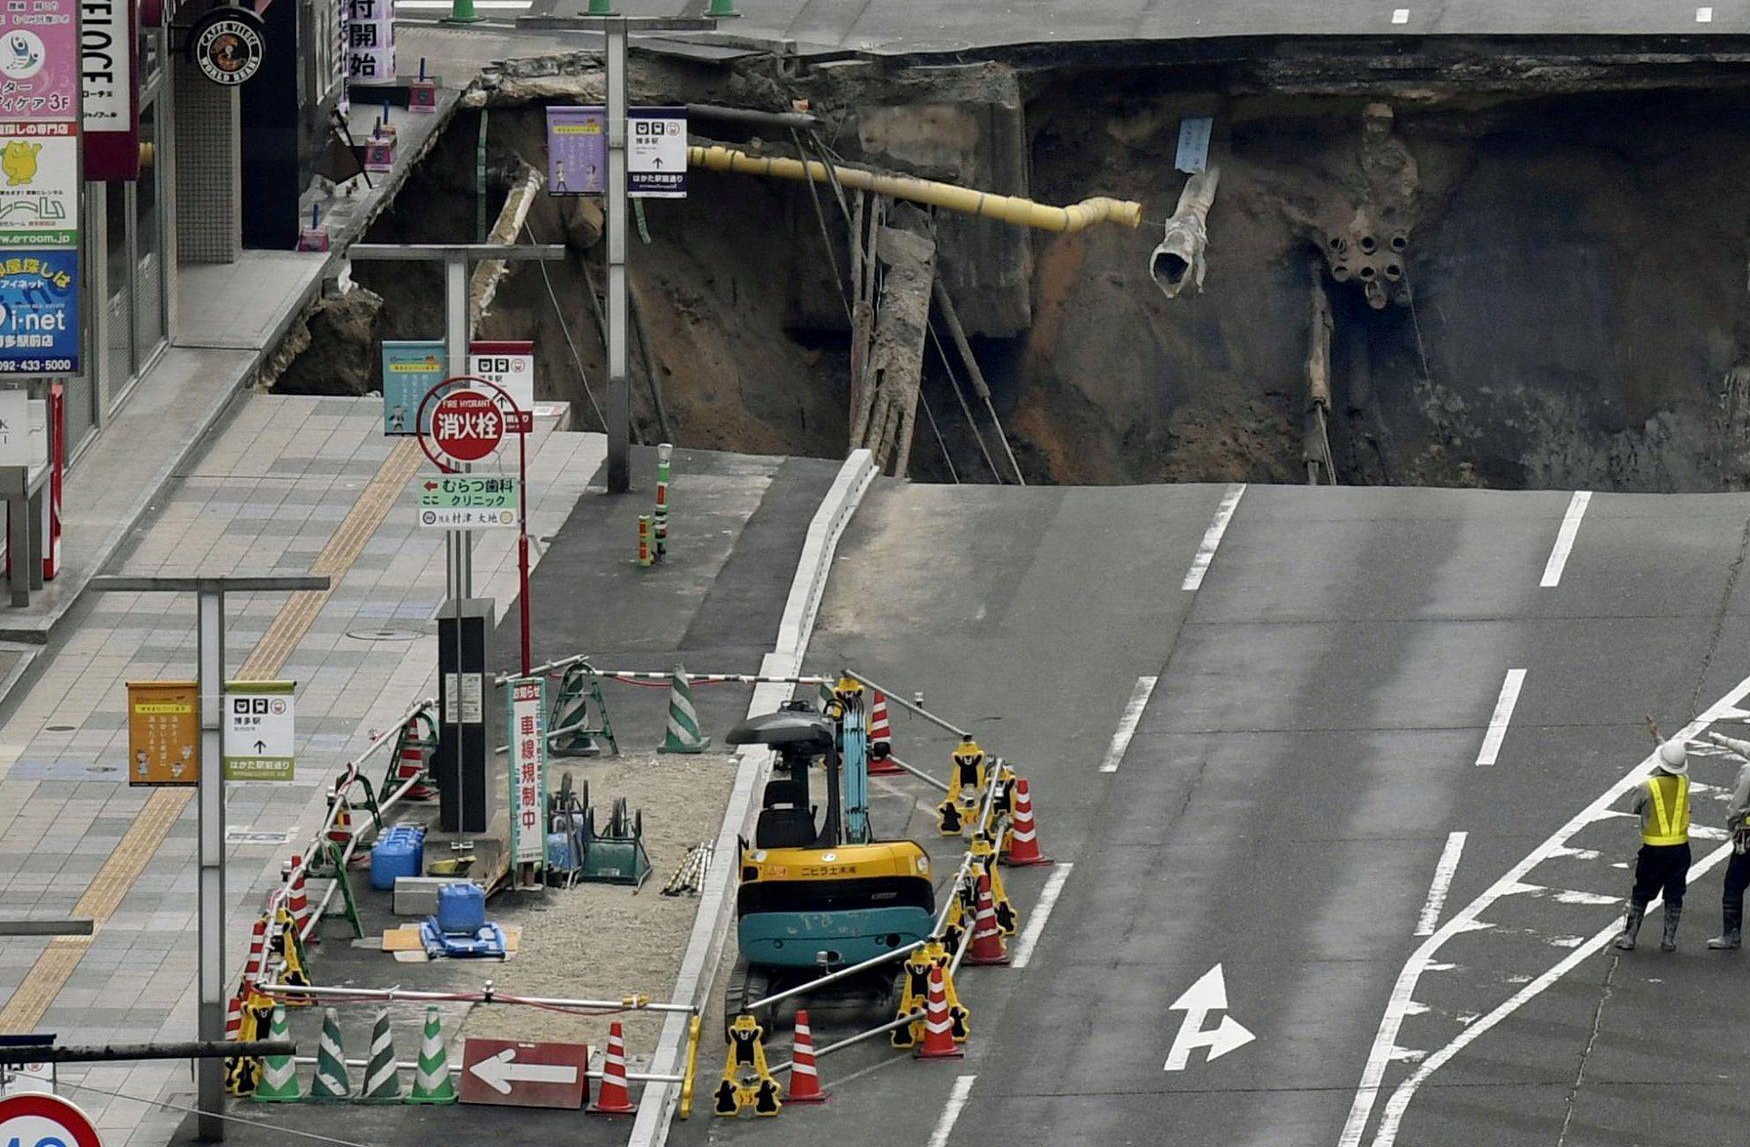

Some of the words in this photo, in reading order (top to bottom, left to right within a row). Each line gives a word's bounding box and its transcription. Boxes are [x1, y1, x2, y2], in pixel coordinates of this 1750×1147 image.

[50, 94, 69, 110] 3F
[438, 411, 499, 440] 消火栓
[443, 479, 513, 494] むらつ歯科
[423, 495, 439, 505] ここ
[452, 495, 505, 507] クリニック
[513, 688, 541, 699] お知らせ
[521, 715, 535, 830] 車線規制中
